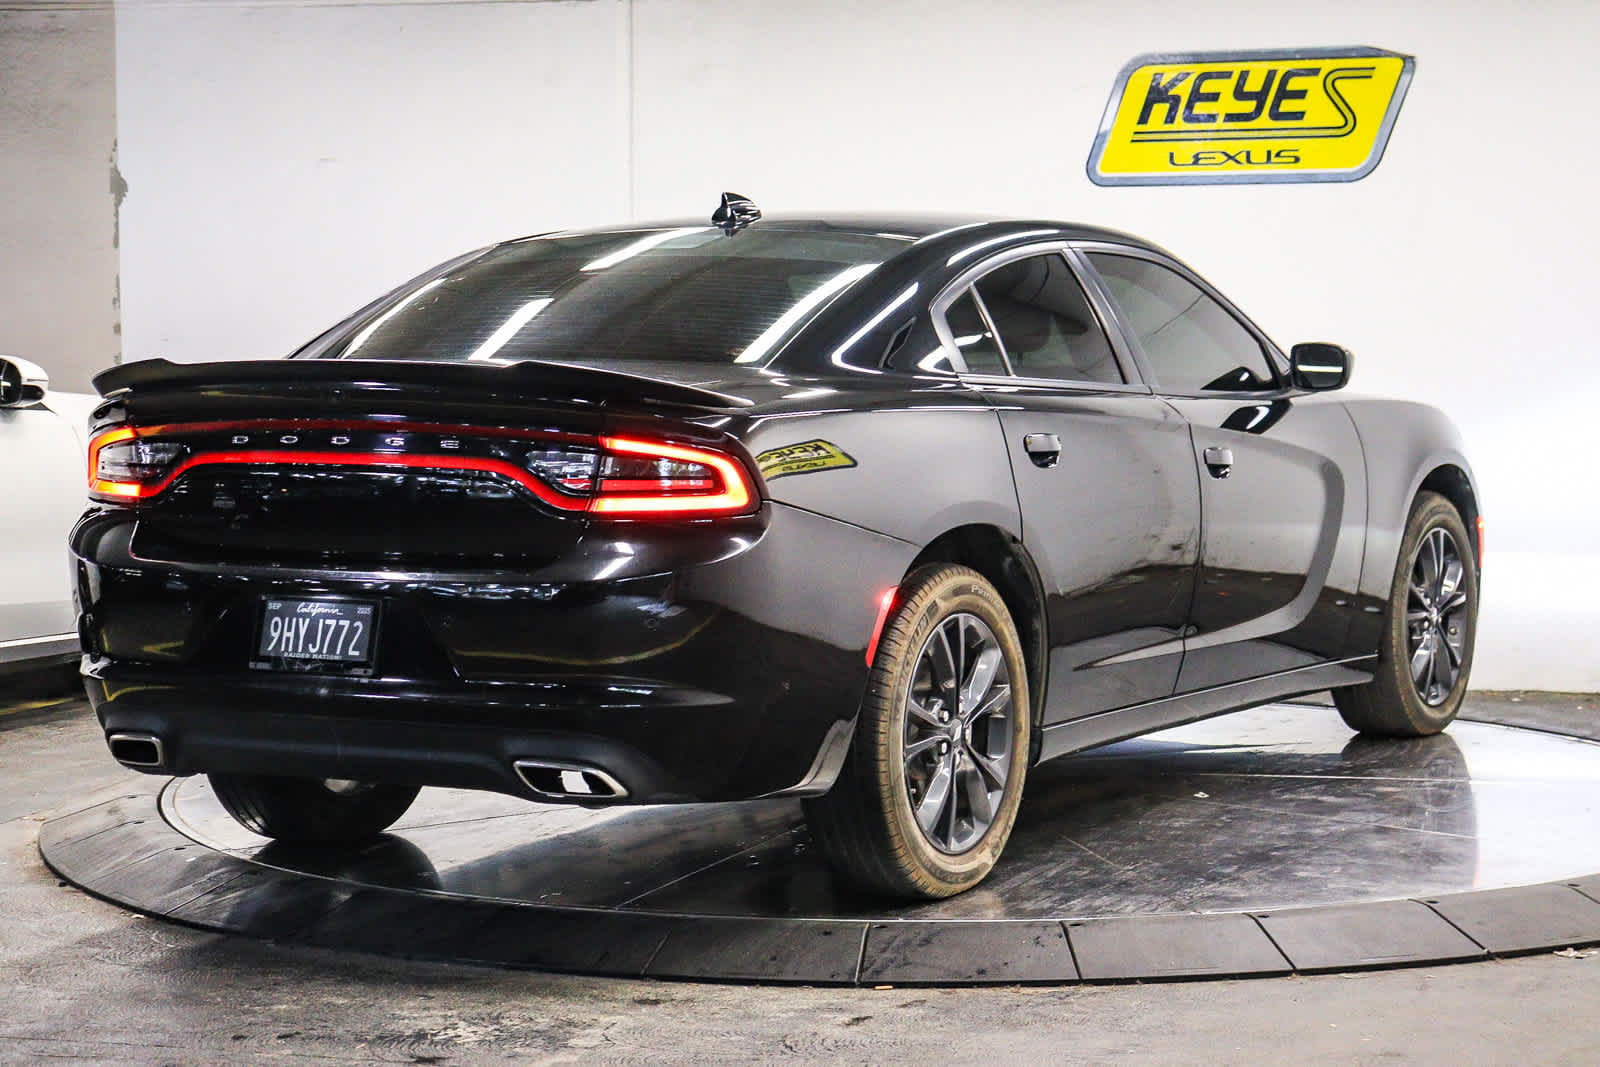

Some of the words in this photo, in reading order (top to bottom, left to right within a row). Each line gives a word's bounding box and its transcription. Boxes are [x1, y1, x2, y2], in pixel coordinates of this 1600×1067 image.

[1134, 66, 1377, 138] KEYES
[1169, 149, 1301, 167] LEXUS
[231, 434, 460, 449] DODGE
[297, 602, 343, 617] California
[267, 616, 364, 656] 9HYJ772
